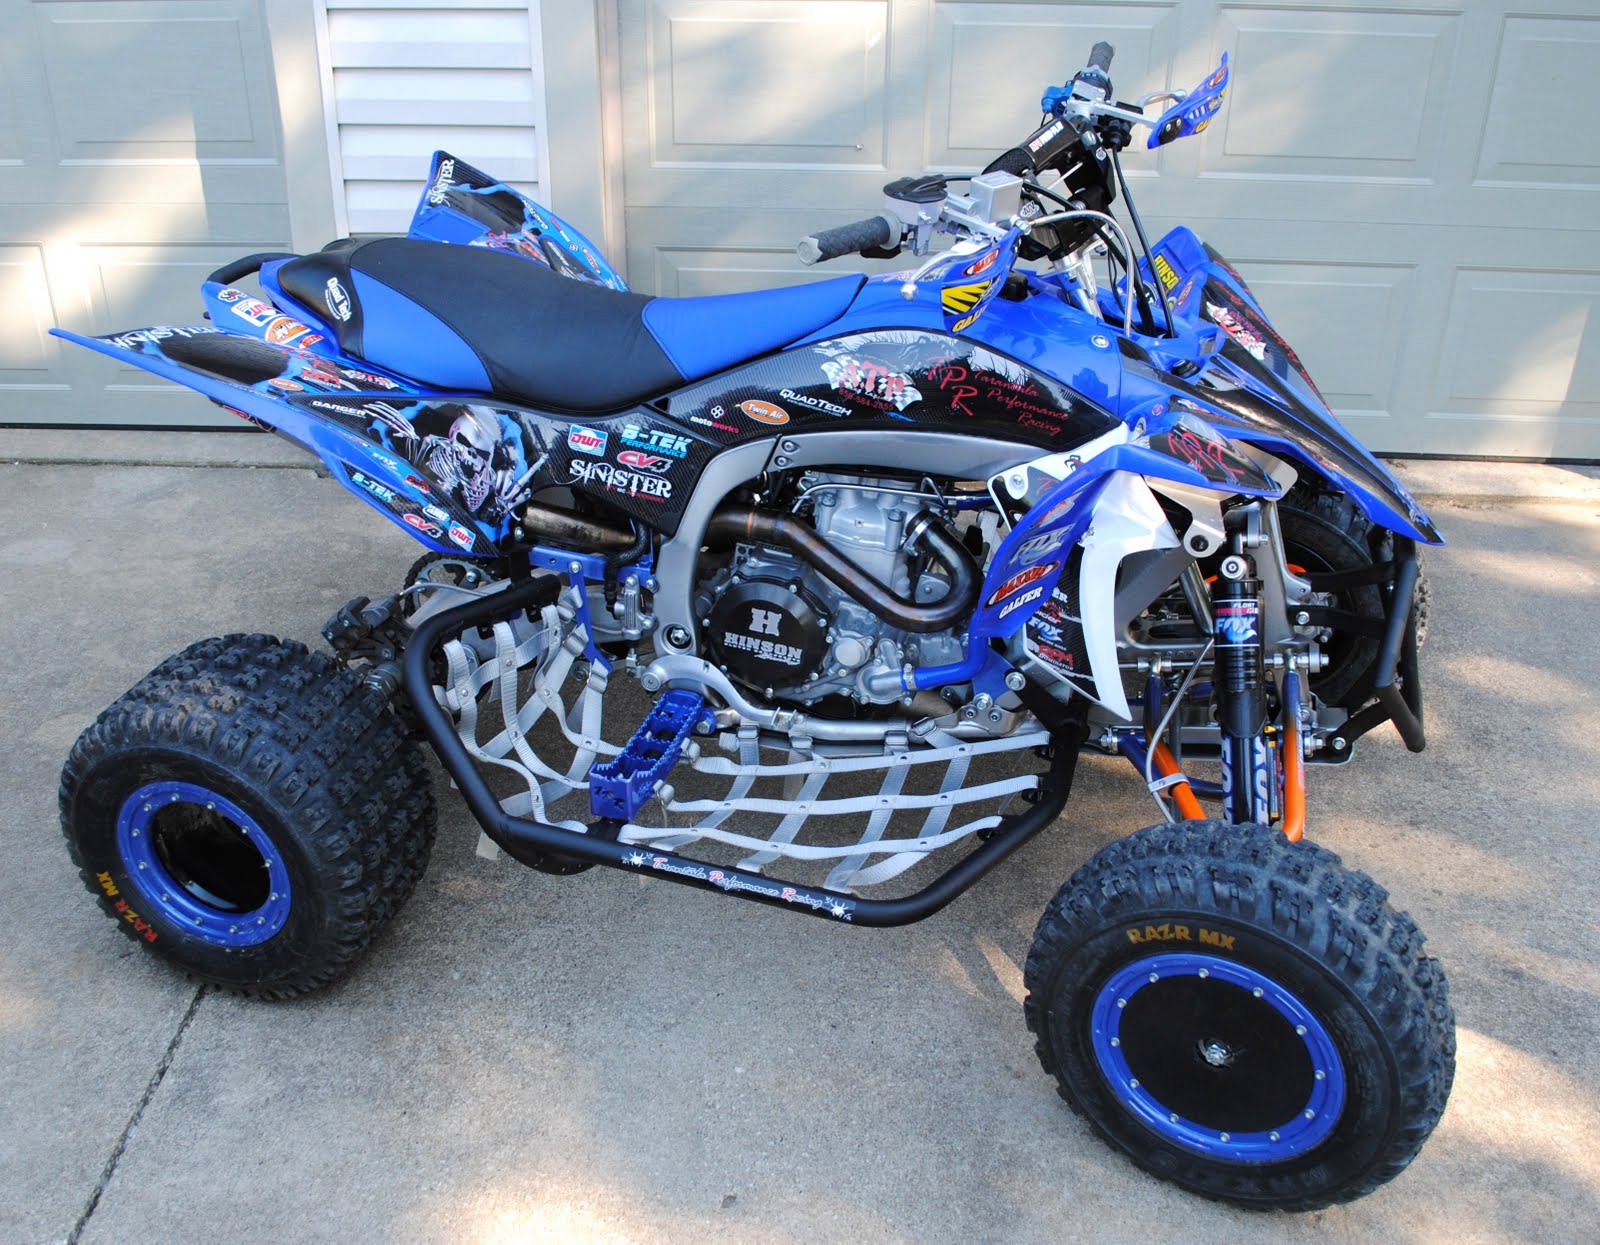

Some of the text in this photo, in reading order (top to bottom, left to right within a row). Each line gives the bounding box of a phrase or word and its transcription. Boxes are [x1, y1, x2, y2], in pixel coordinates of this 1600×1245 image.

[748, 403, 783, 420] Twin Air
[1018, 411, 1063, 437] Racing
[571, 433, 604, 448] DWT
[621, 424, 693, 453] B-TEK
[617, 450, 673, 473] CV4
[403, 513, 443, 539] CV4
[451, 528, 473, 545] DWT
[1215, 617, 1256, 634] FOX
[724, 631, 803, 660] HINSON
[708, 869, 780, 891] Performance
[1126, 922, 1237, 951] RAZR MX
